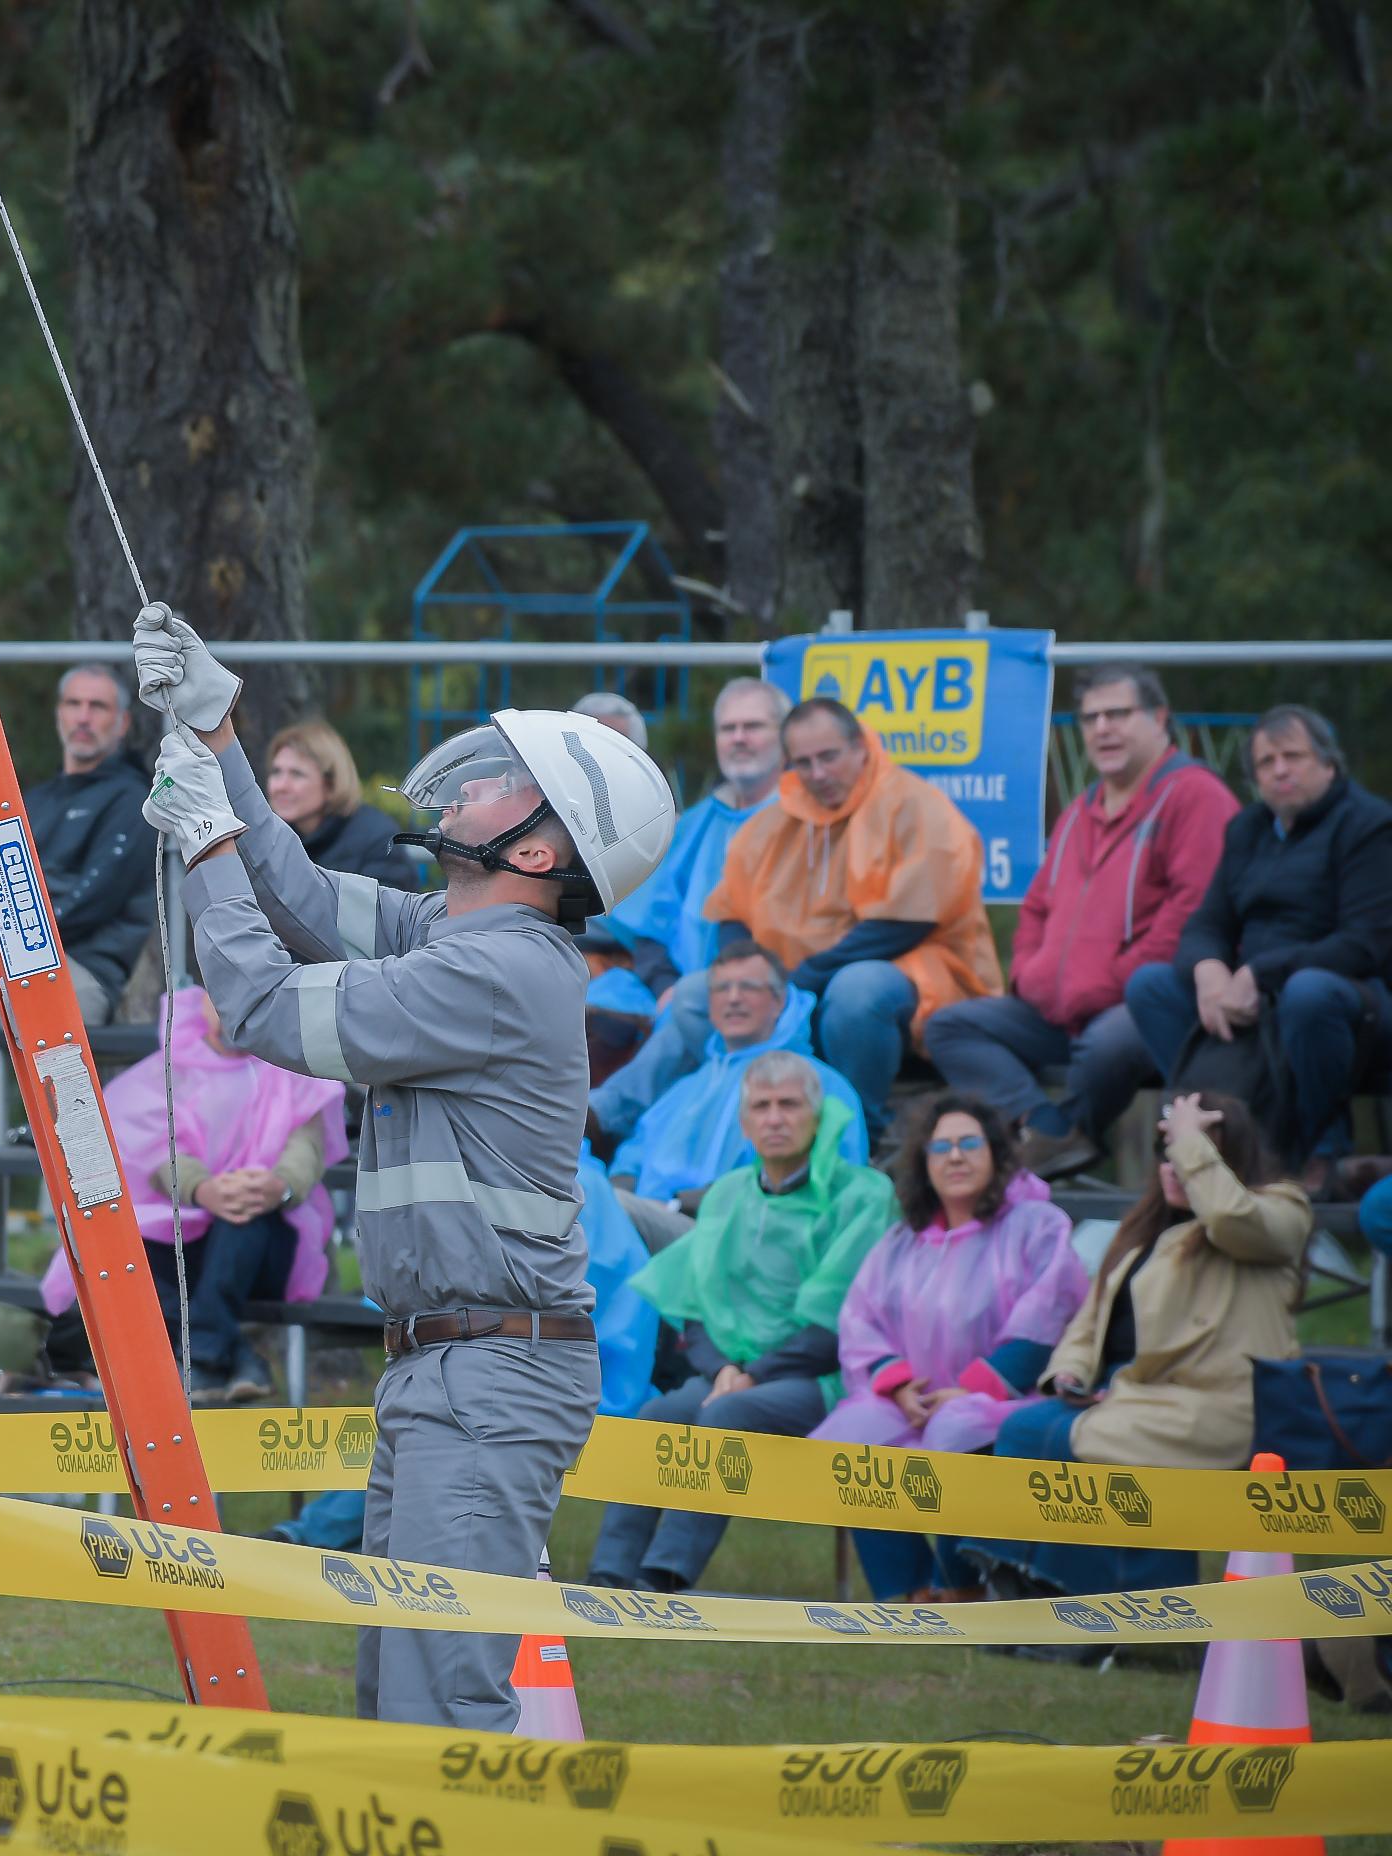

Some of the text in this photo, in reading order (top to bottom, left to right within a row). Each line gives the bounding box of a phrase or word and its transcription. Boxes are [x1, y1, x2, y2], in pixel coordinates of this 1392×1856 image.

[87, 1532, 127, 1561] PARE
[130, 1521, 217, 1567] ute
[145, 1560, 224, 1589] TRABAJANDO
[327, 1570, 370, 1594] PARE
[369, 1558, 457, 1600] ute
[610, 1591, 702, 1621] ute
[1101, 1592, 1197, 1620] ute
[1309, 1587, 1358, 1607] PARE
[854, 1603, 949, 1627] ute
[36, 1746, 129, 1824] ute
[336, 1793, 442, 1856] ute
